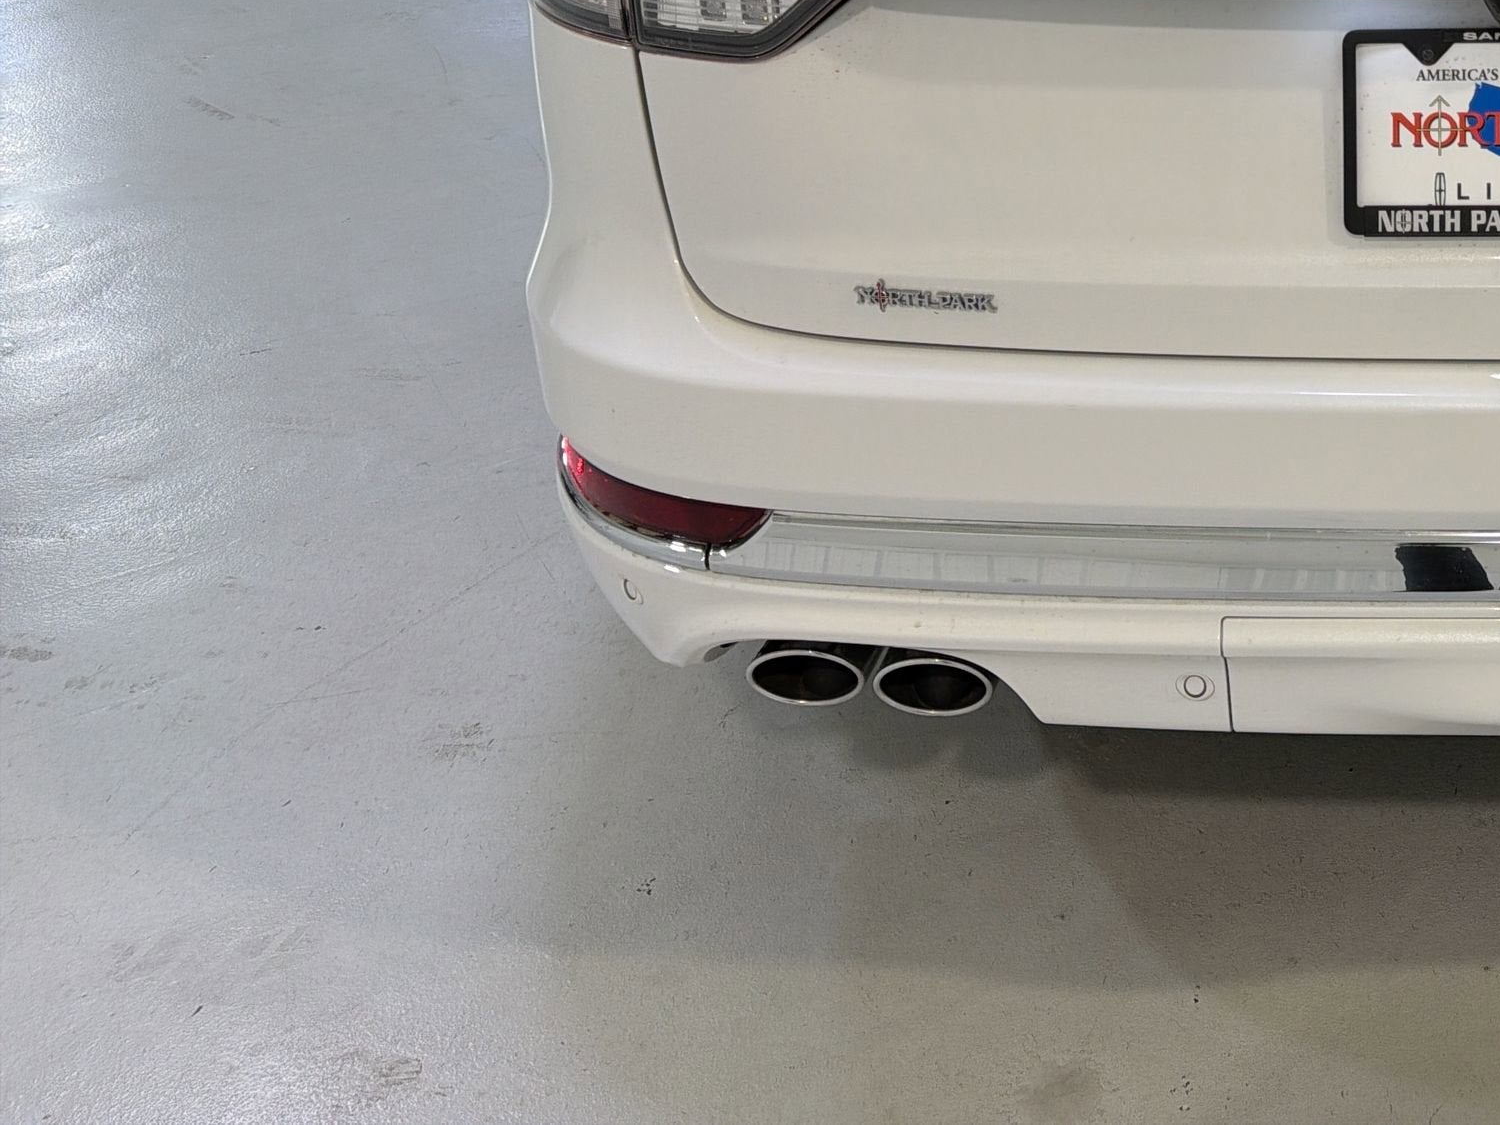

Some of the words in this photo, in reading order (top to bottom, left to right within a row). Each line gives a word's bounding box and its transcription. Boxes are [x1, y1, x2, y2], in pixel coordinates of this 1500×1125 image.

[1416, 68, 1499, 82] AMERICA'S
[1377, 209, 1462, 233] NORTH
[853, 284, 932, 309] NORTH
[935, 290, 998, 313] PARK
